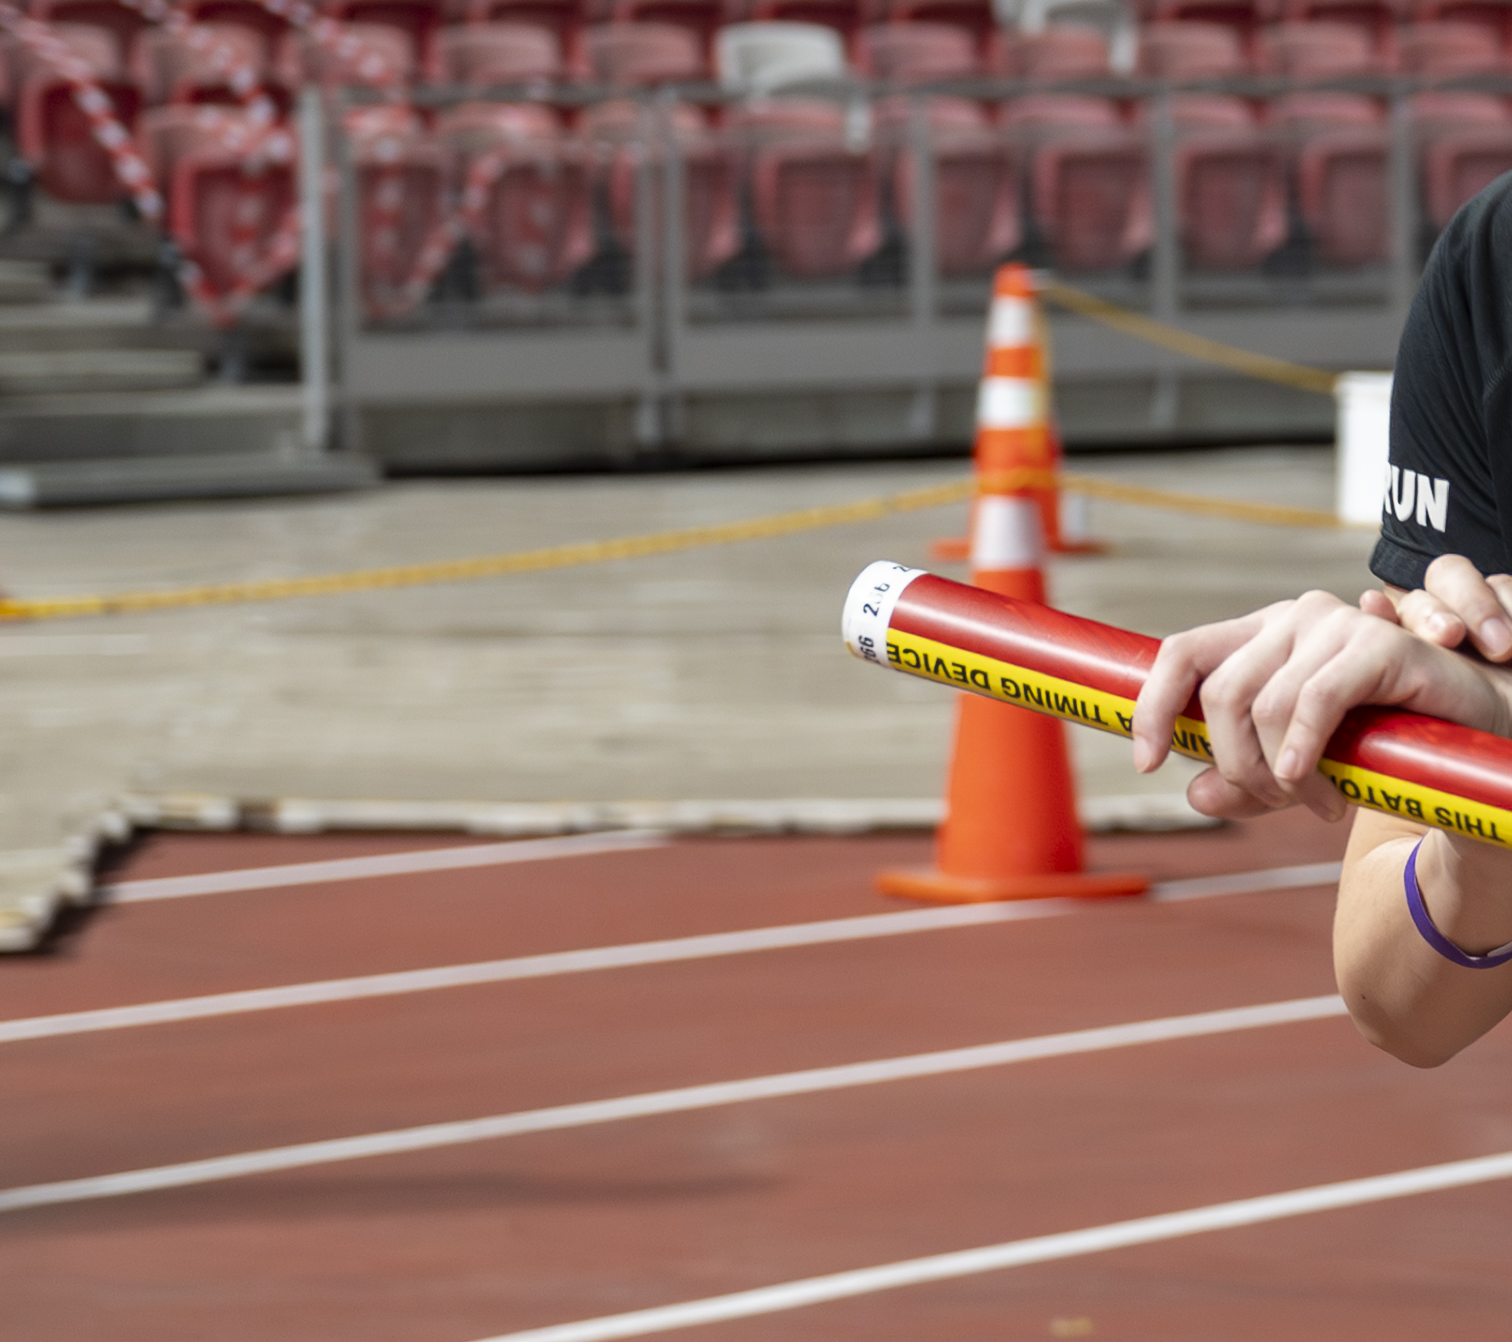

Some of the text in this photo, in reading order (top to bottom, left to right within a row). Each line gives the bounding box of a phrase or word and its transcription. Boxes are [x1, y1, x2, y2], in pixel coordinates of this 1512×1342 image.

[885, 641, 992, 692] DEVICE
[999, 676, 1110, 727] TIMING
[1433, 805, 1506, 844] THIS
